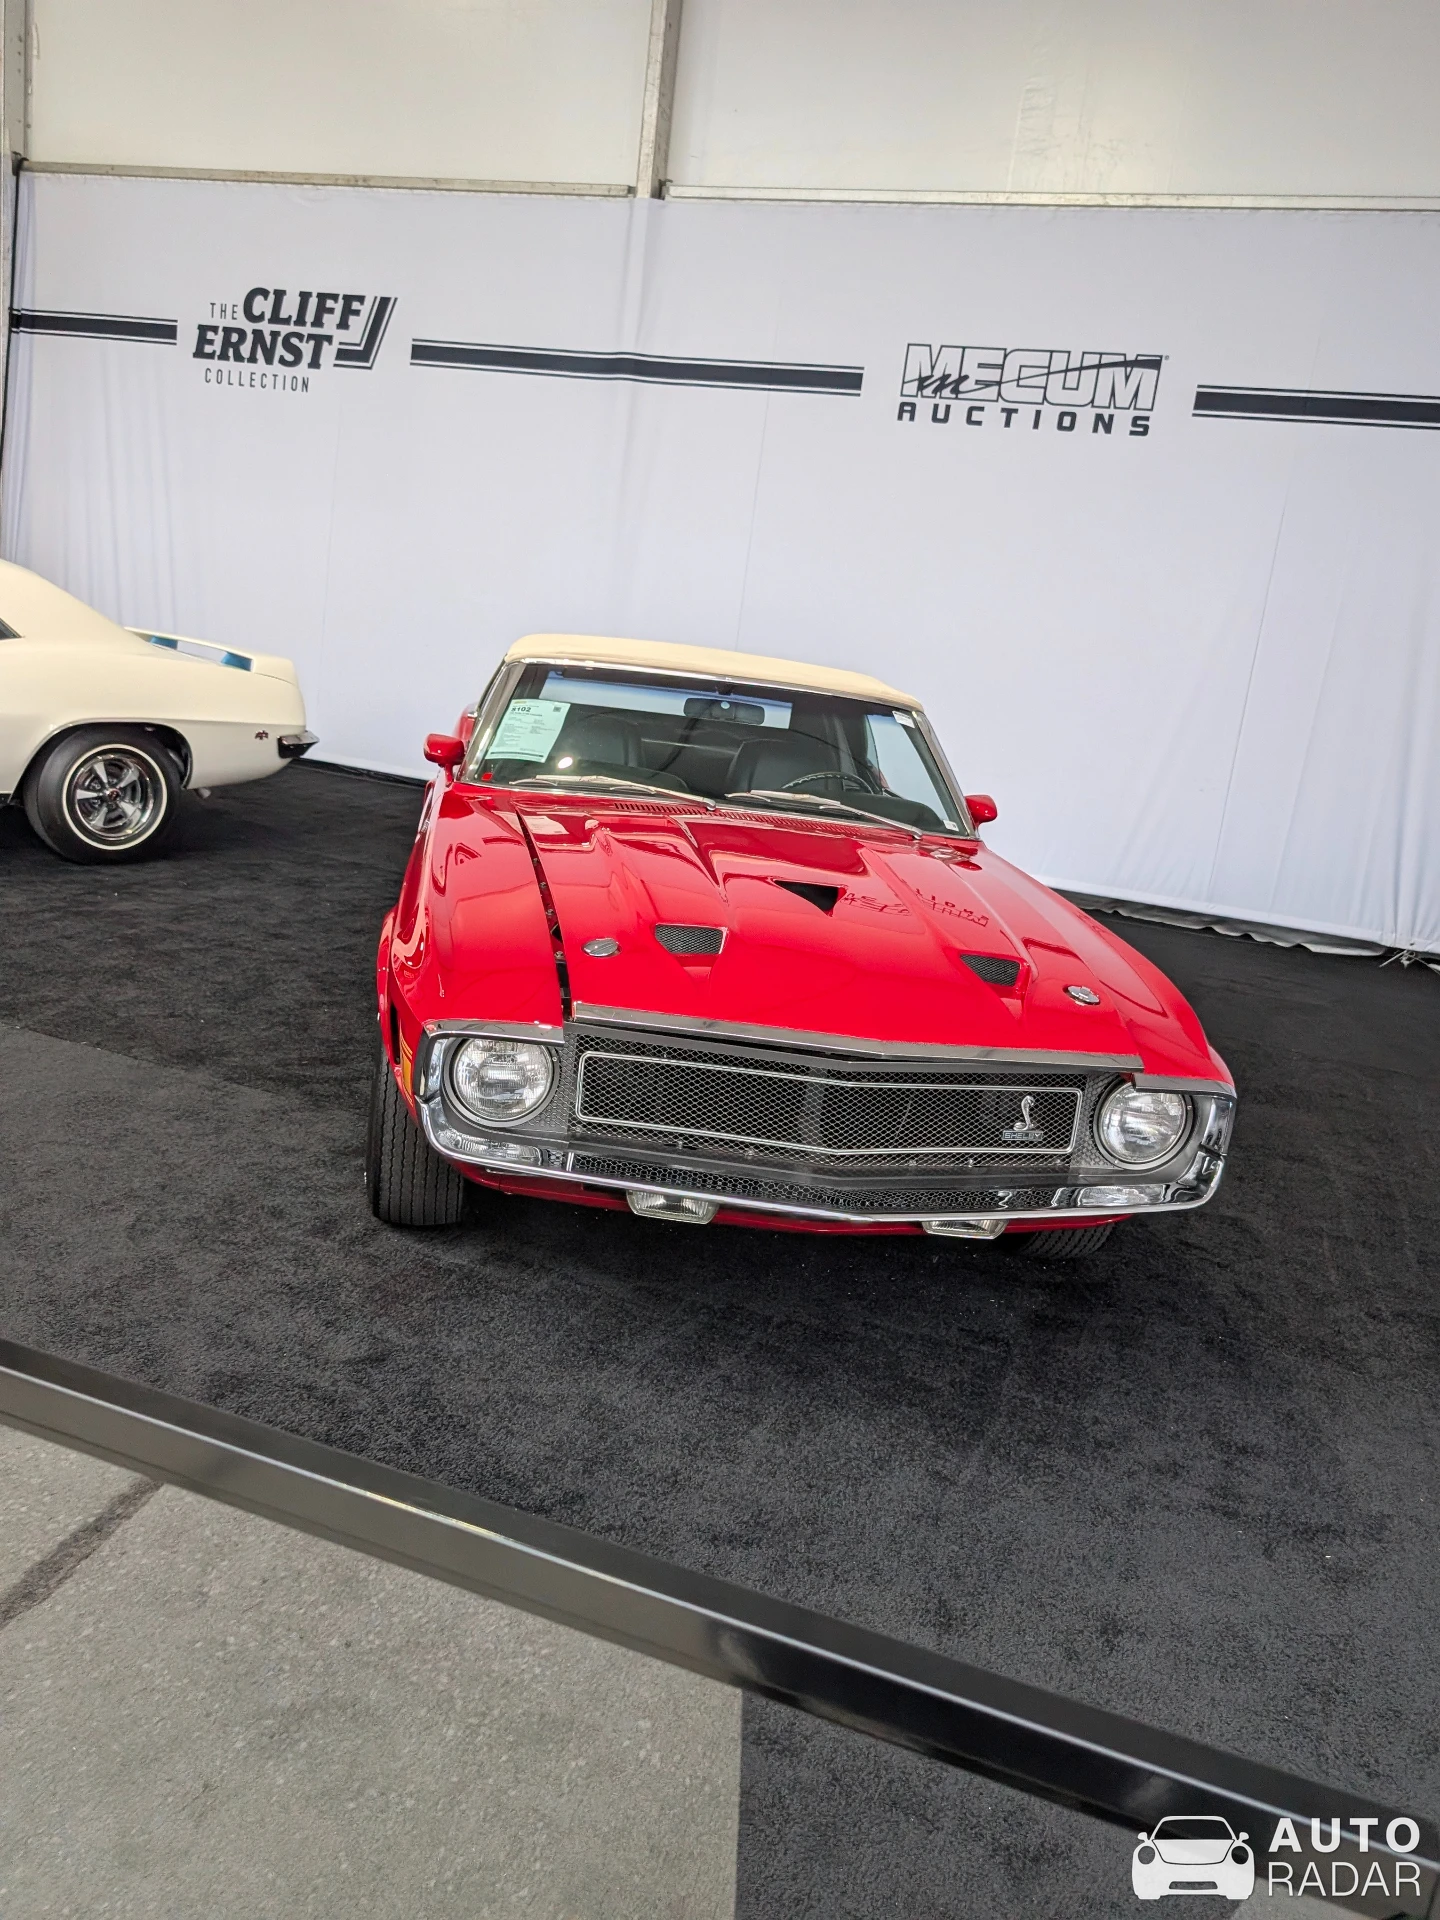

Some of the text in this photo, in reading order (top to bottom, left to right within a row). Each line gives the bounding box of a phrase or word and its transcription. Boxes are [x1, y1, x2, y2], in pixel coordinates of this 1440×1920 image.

[210, 287, 366, 331] THE CLIFF
[192, 324, 334, 370] ERNST
[204, 367, 310, 393] COLLECTION
[900, 343, 1163, 411] MECUM
[897, 401, 1150, 437] AUCTIONS
